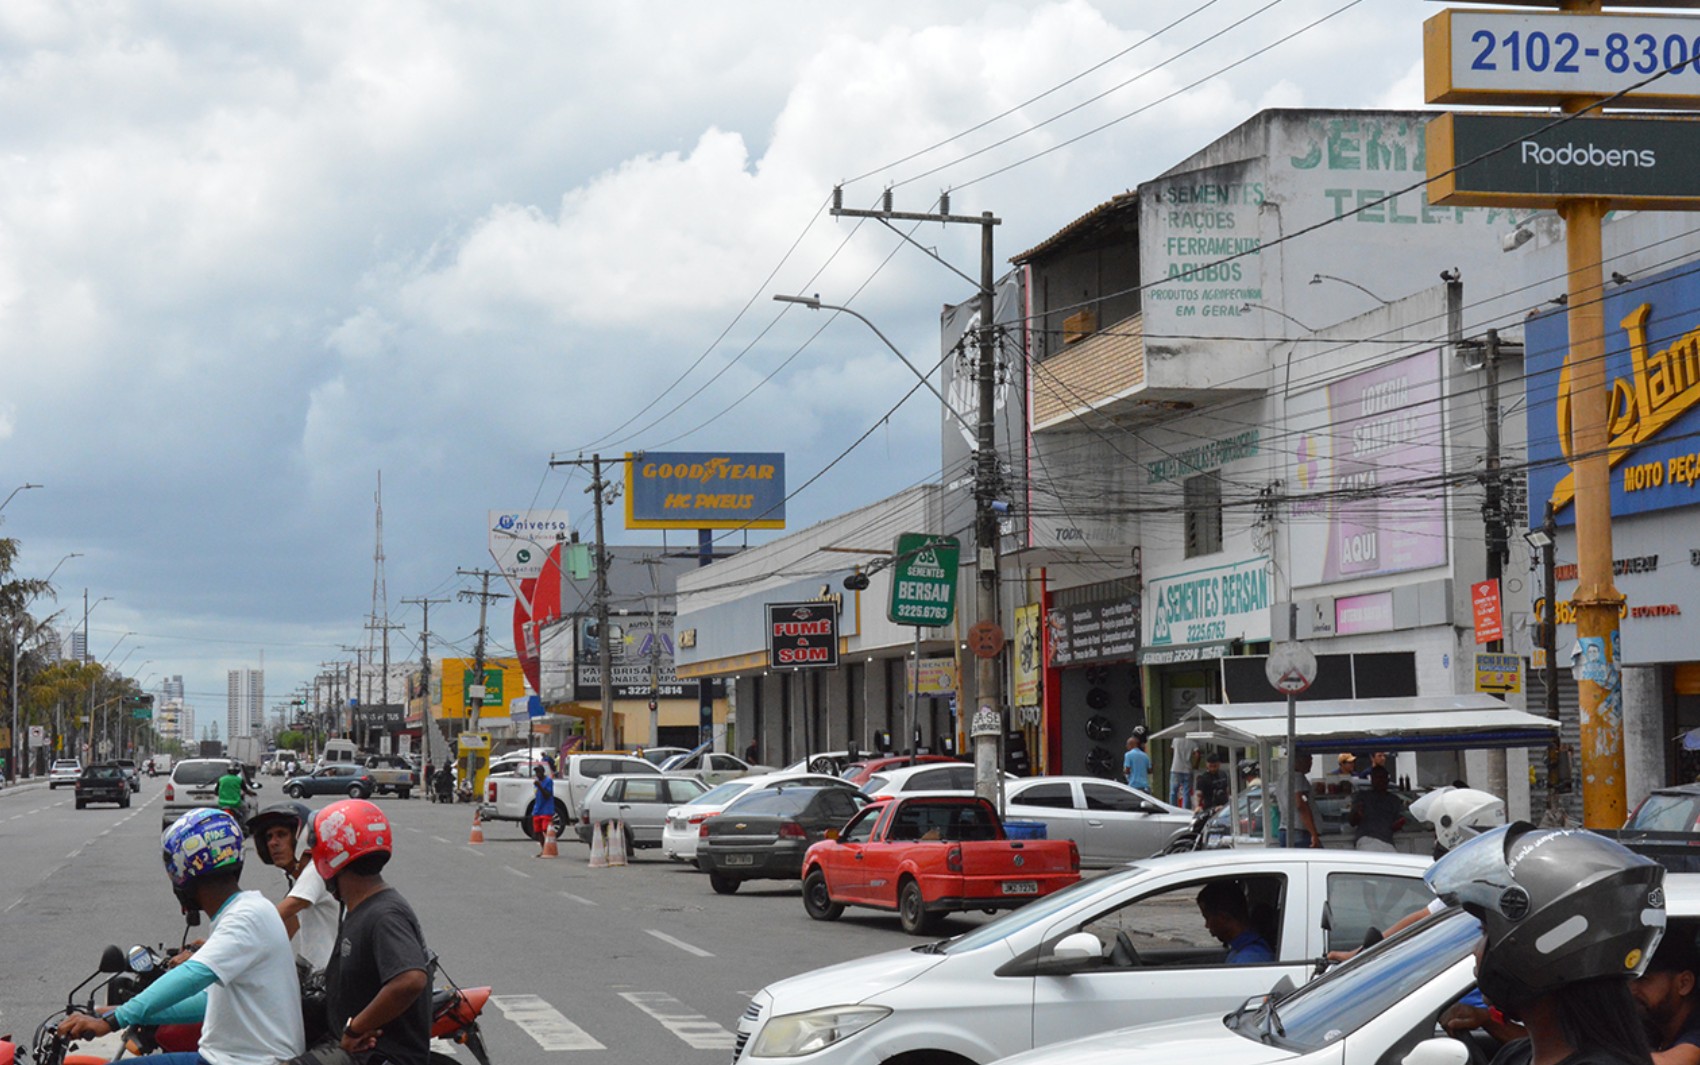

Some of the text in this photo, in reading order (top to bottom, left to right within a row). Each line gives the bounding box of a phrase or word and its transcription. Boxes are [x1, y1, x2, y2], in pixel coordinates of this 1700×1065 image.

[1470, 30, 1700, 75] 2102-830
[1520, 140, 1656, 168] Rodobens
[1168, 182, 1265, 206] SEMENTES
[1168, 208, 1236, 234] RAÇÕES
[1151, 289, 1199, 301] PRODUTOS
[1175, 305, 1242, 317] EM GERAL
[642, 460, 775, 482] GOODYEAR
[1624, 466, 1664, 493] MOTO
[664, 493, 755, 510] HC PNEUS
[499, 514, 566, 531] Universo
[1341, 532, 1377, 565] AQUI
[906, 565, 946, 579] SEMENTES
[898, 580, 950, 603] BERSAN
[1166, 565, 1268, 625] SEMENTES BERSAN
[1630, 604, 1680, 618] HONDA
[778, 647, 829, 663] SOM
